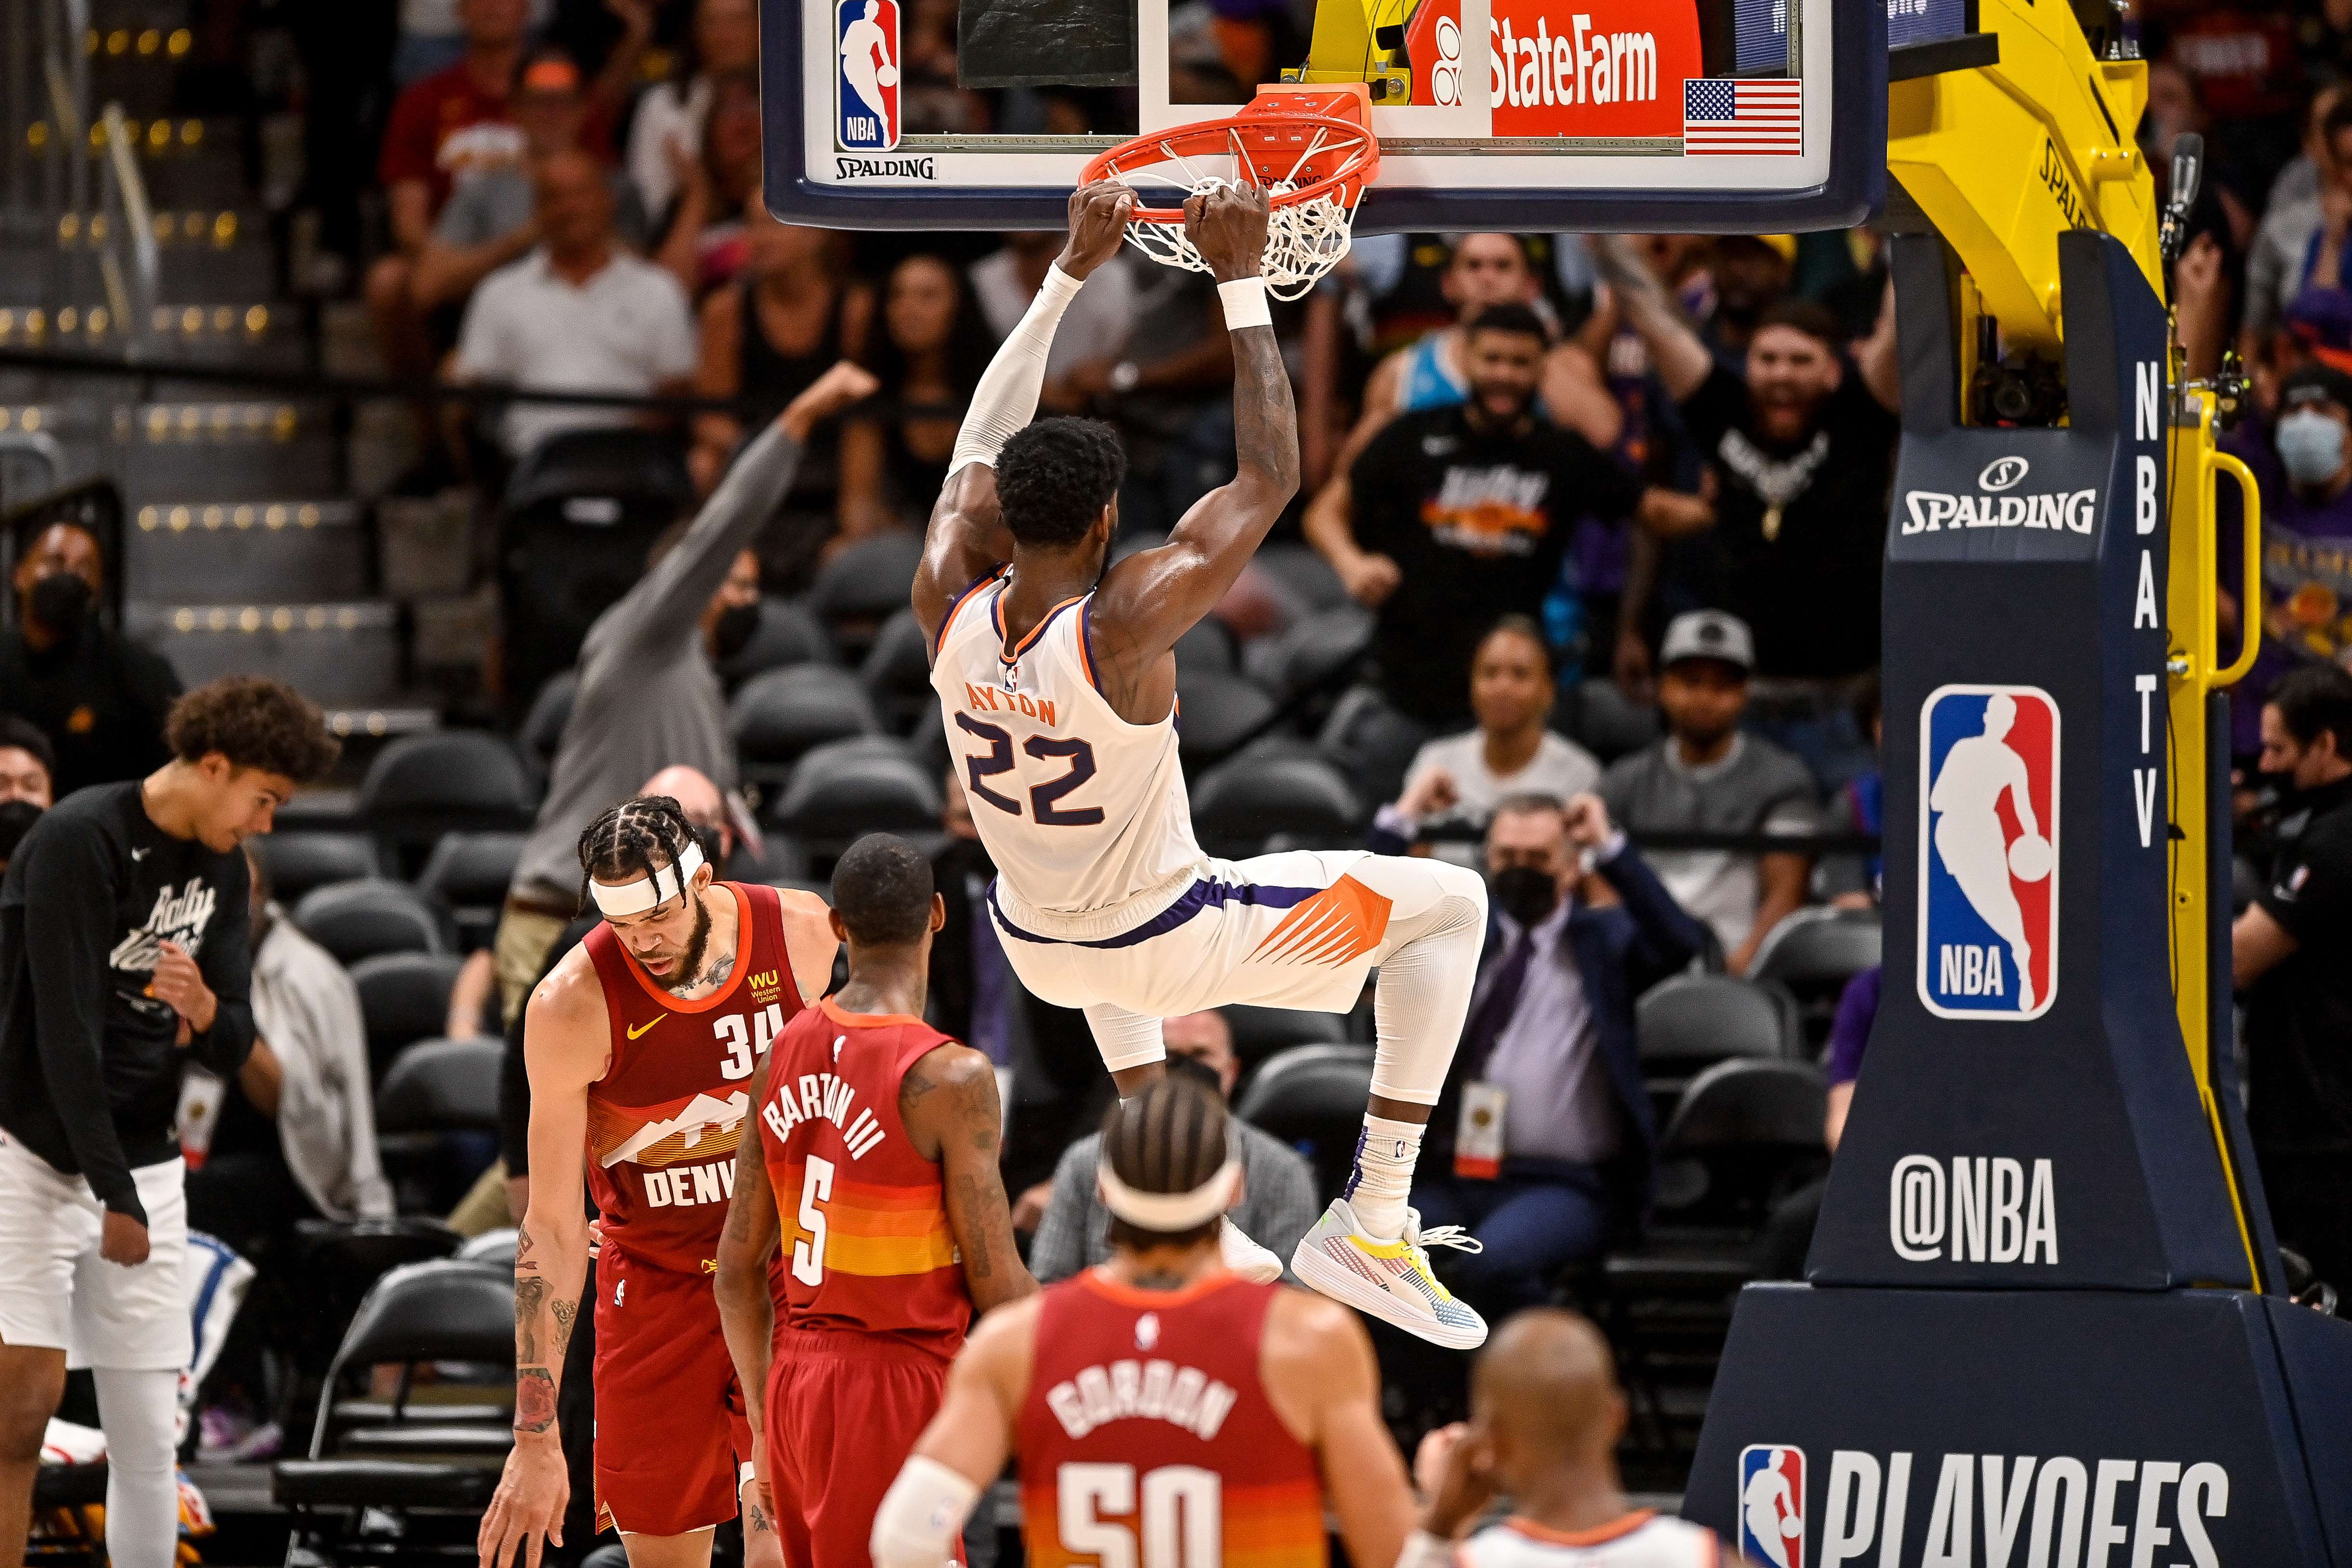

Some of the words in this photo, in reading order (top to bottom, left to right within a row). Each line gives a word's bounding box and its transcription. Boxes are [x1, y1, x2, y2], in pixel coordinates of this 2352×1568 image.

[847, 117, 877, 141] NBA
[836, 157, 933, 180] SPALDING
[1901, 488, 2097, 535] SPALDING
[965, 682, 1055, 727] AYTON
[955, 710, 1105, 826] 22
[748, 970, 778, 990] WU
[751, 986, 781, 998] Western
[757, 994, 778, 1003] Union
[1940, 944, 2004, 996] NBA
[713, 1003, 784, 1080] 34
[762, 1073, 856, 1143] BARTON
[843, 1106, 886, 1161] III
[792, 1154, 835, 1287] 5
[1890, 1154, 2059, 1264] @NBA
[1045, 1359, 1238, 1441] GORDON
[1056, 1462, 1223, 1568] 50
[1820, 1450, 2229, 1568] PLAYOFFS
